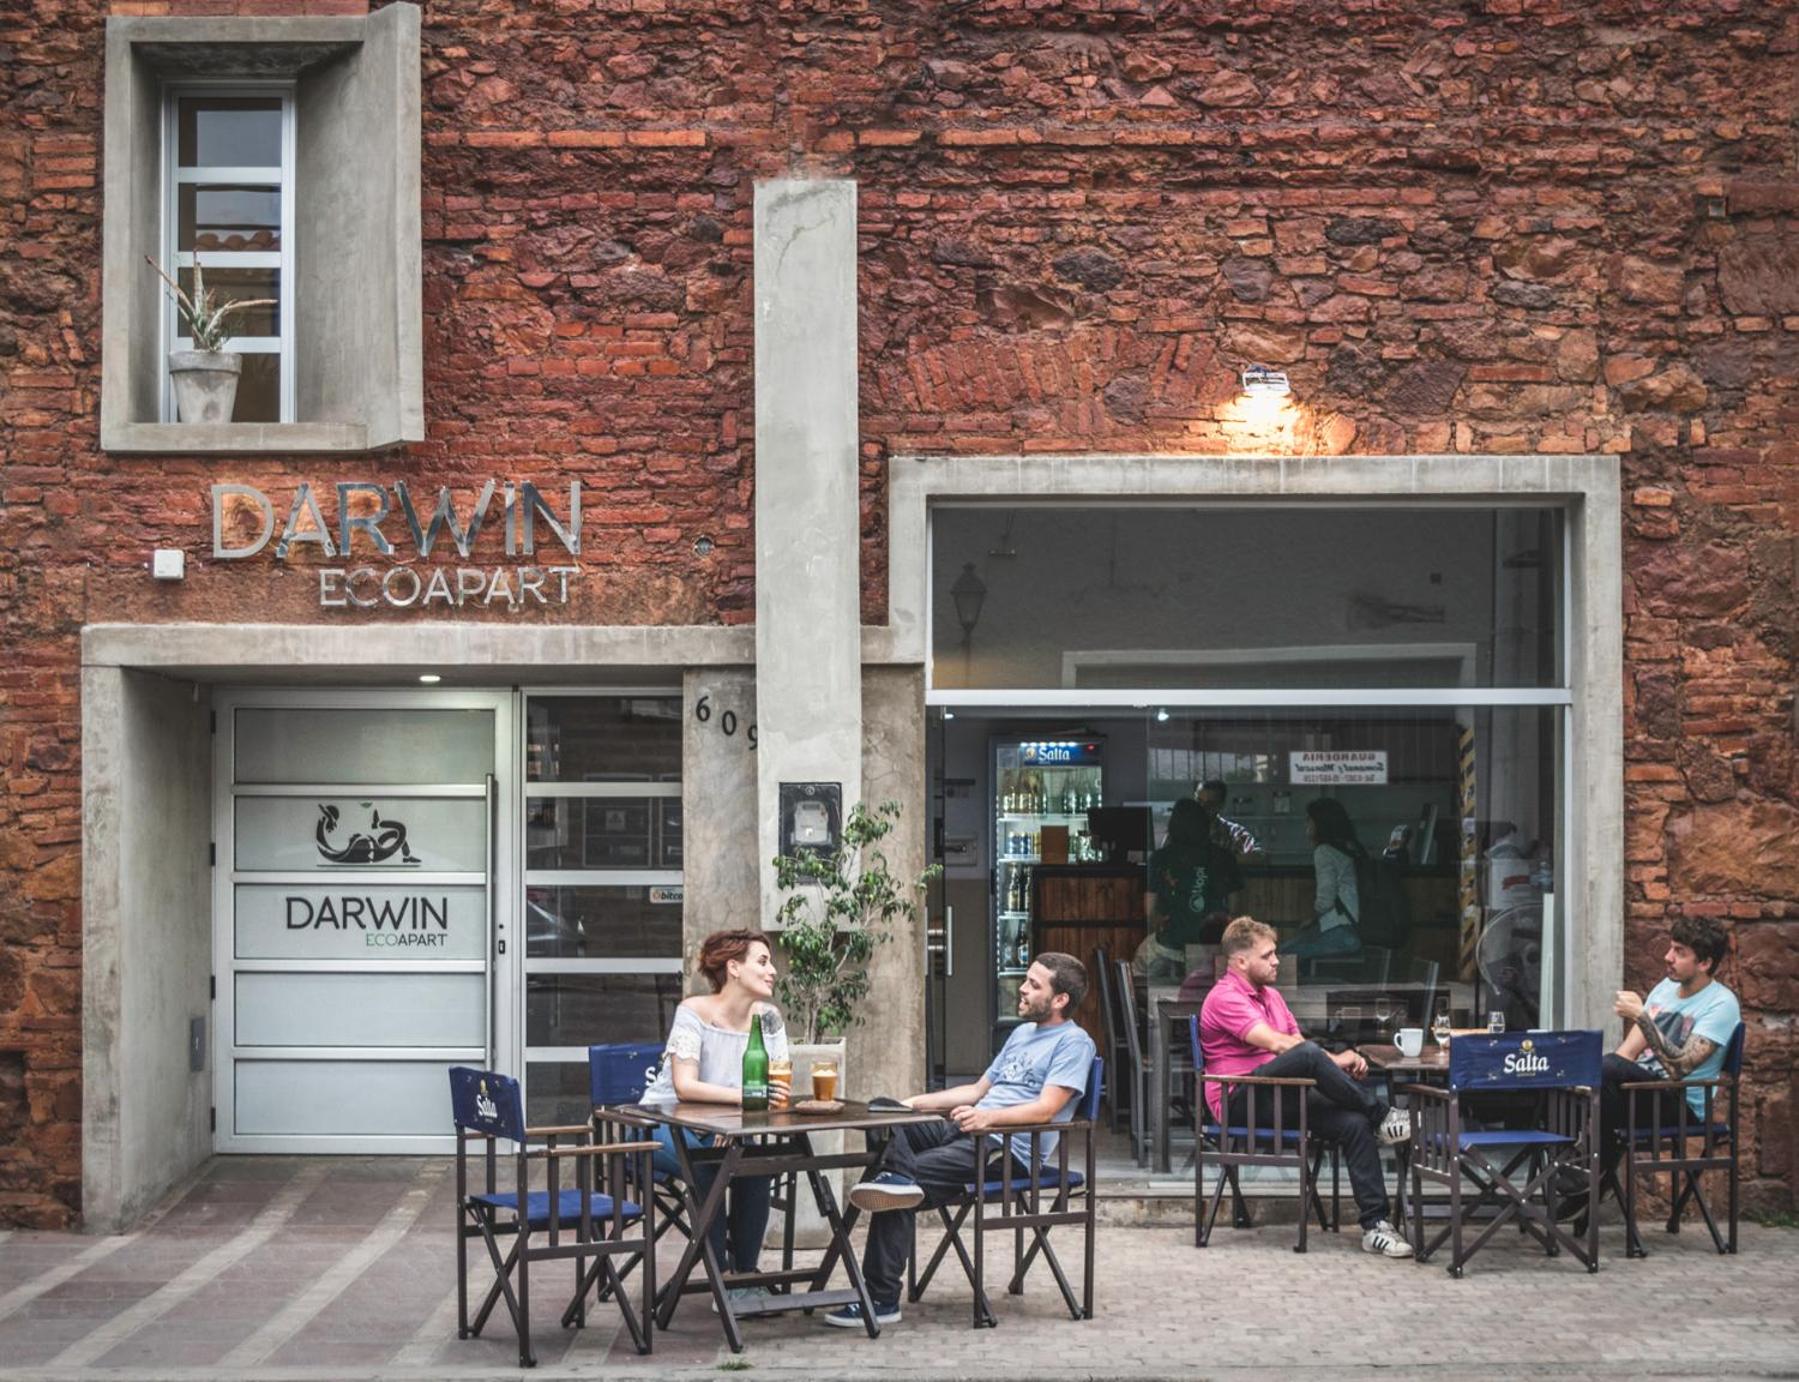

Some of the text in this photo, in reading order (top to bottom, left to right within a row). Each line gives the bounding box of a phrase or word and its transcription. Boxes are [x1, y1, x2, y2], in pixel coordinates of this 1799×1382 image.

[211, 480, 583, 559] DARWIN
[318, 566, 581, 607] ECOAPART
[695, 695, 758, 751] 609
[1038, 746, 1072, 761] Salta
[285, 896, 448, 931] DARWIN
[365, 933, 449, 947] ECOAPART
[1503, 1053, 1551, 1074] Salta
[476, 1094, 498, 1118] Salta
